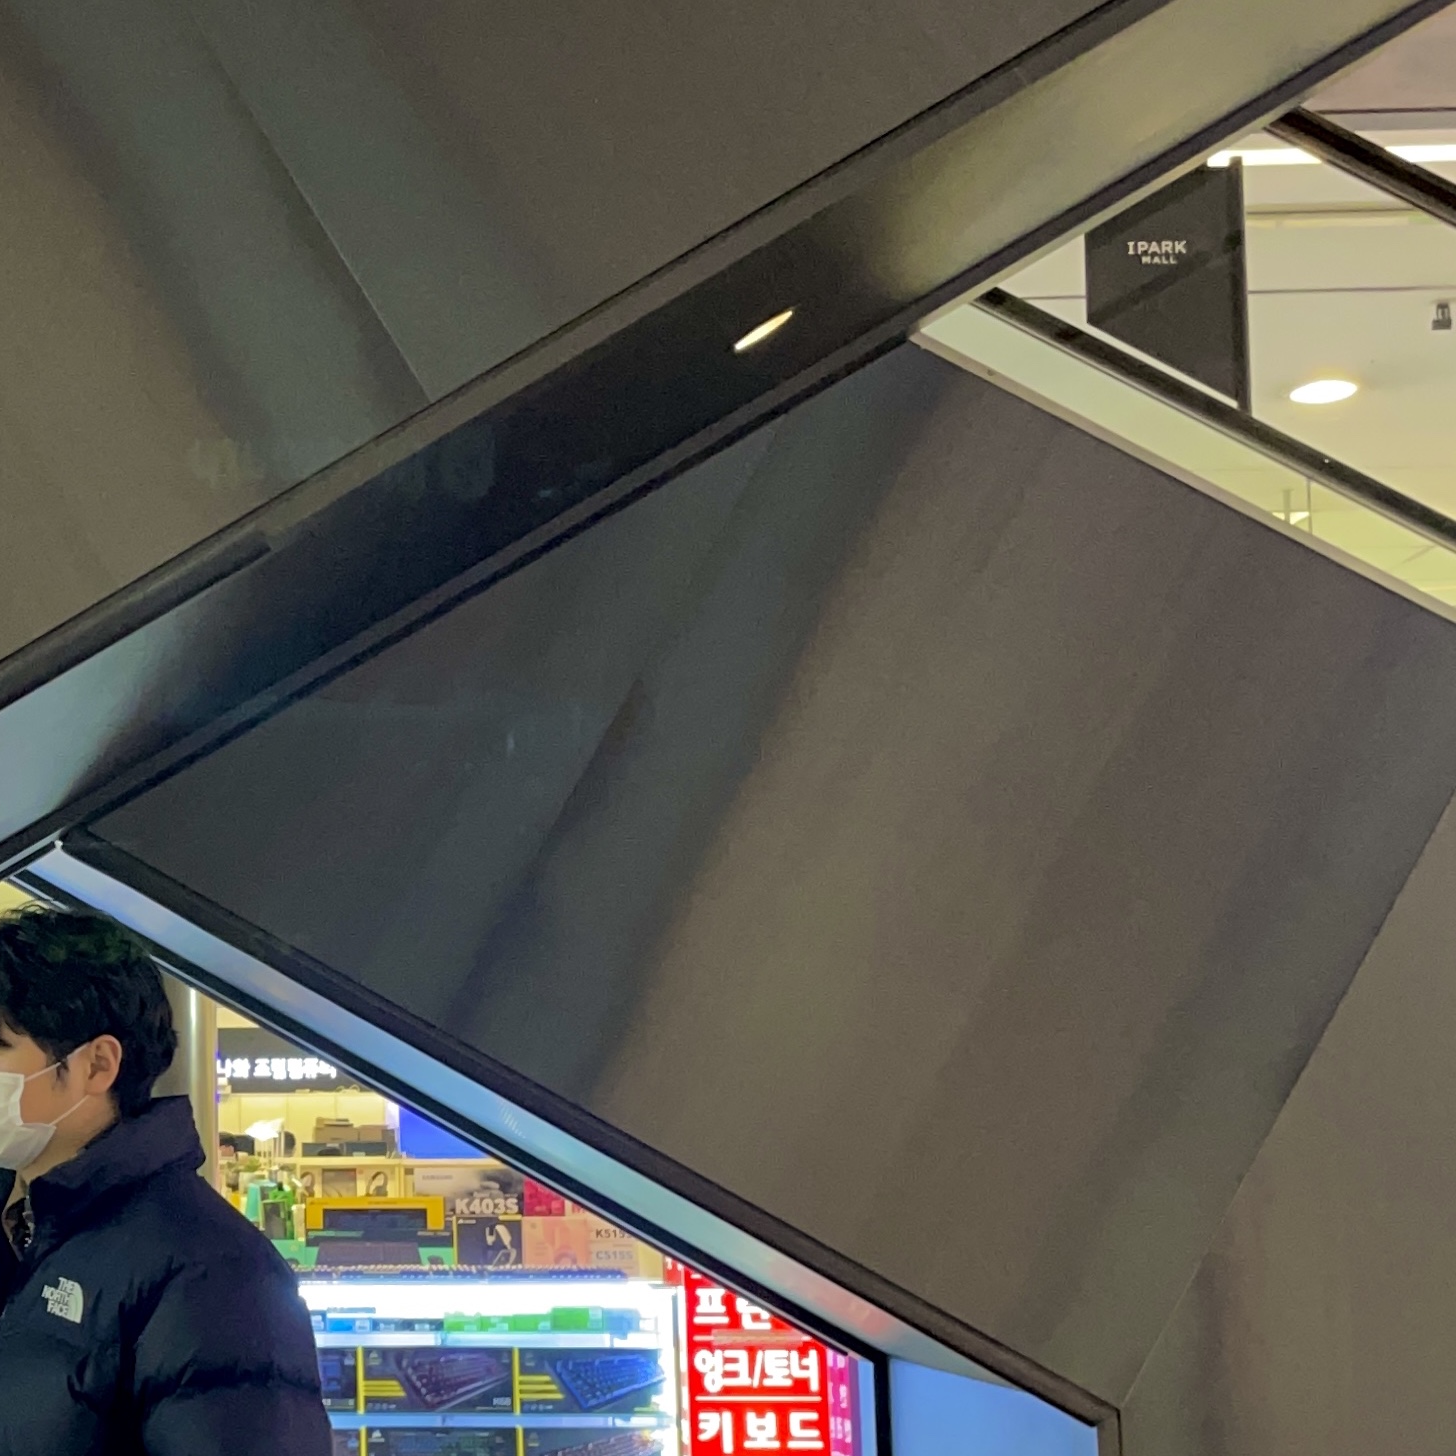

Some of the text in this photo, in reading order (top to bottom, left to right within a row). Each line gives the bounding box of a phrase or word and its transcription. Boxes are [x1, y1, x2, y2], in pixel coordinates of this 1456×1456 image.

[1141, 255, 1177, 265] MALL
[455, 1197, 519, 1215] K403S
[697, 1410, 825, 1455] 키보드
